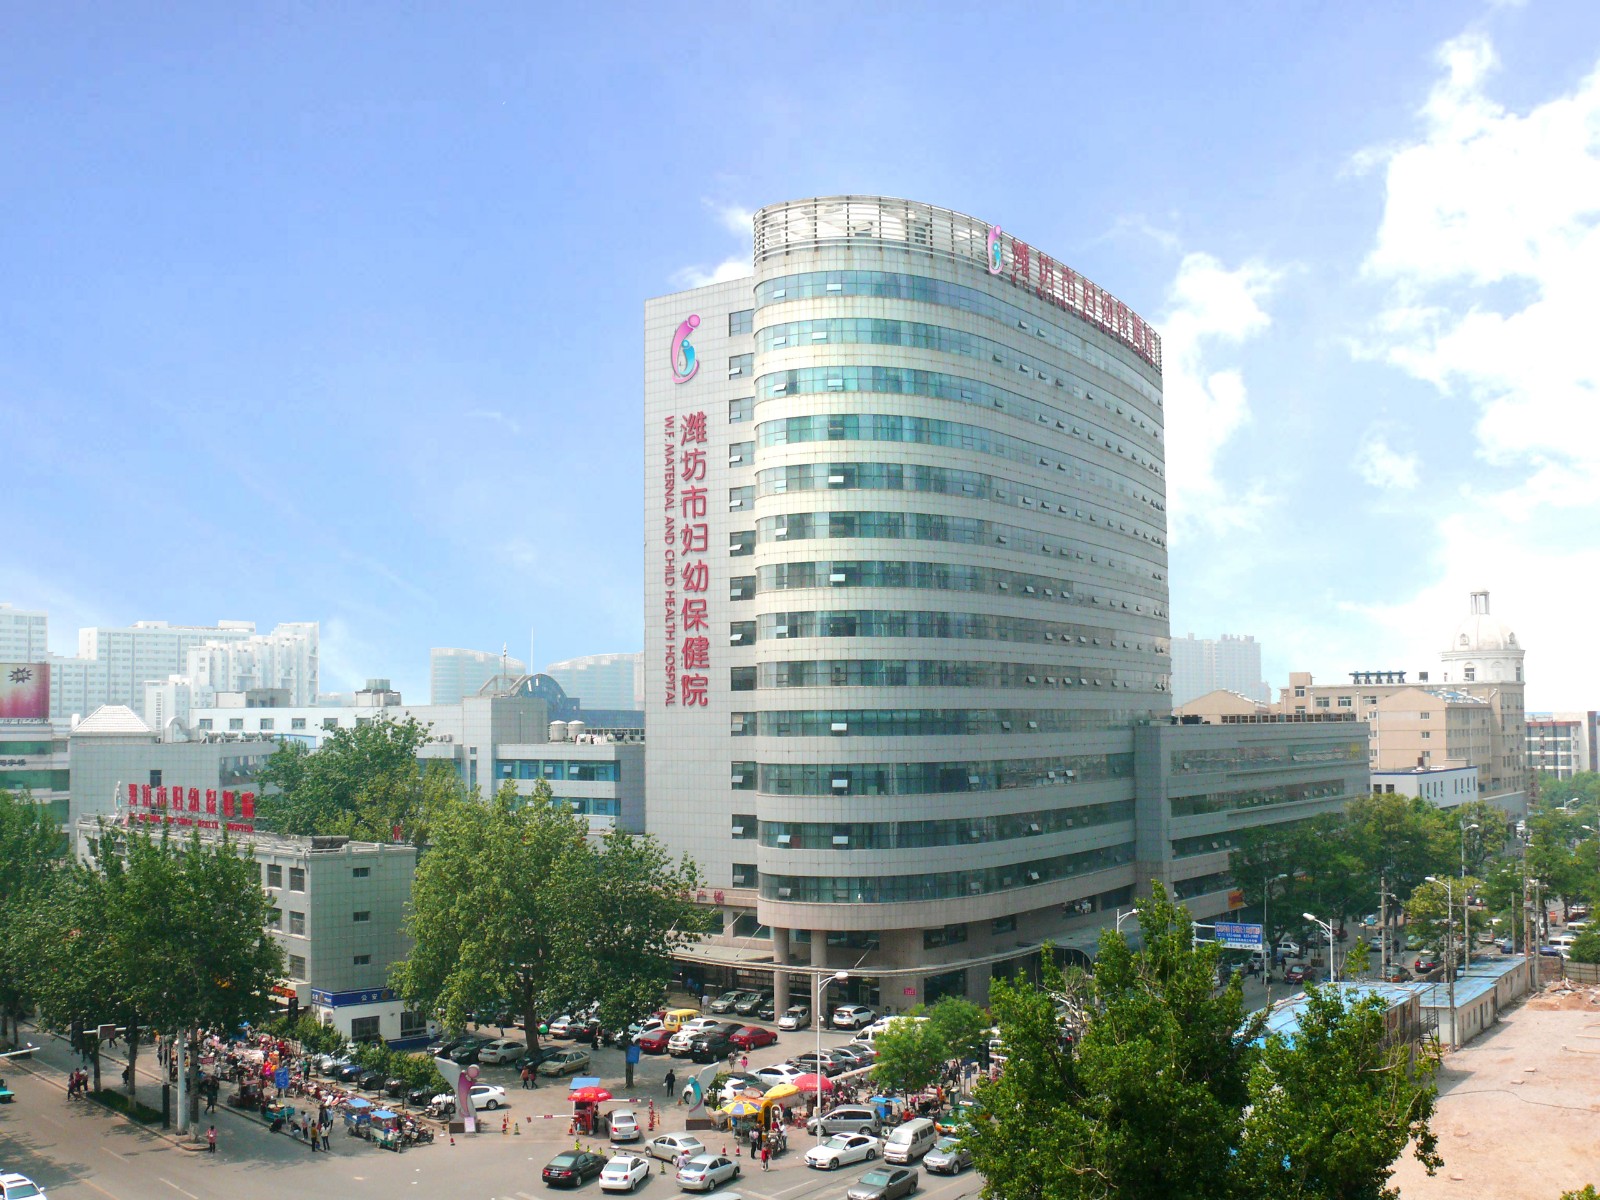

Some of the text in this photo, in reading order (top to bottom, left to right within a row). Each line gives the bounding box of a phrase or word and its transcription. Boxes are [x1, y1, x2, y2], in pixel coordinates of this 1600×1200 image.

[664, 415, 676, 707] W.F. MATERNAL AND CHILD HEALTH HOSPITAL
[680, 410, 710, 707] 潍坊市妇幼保健院
